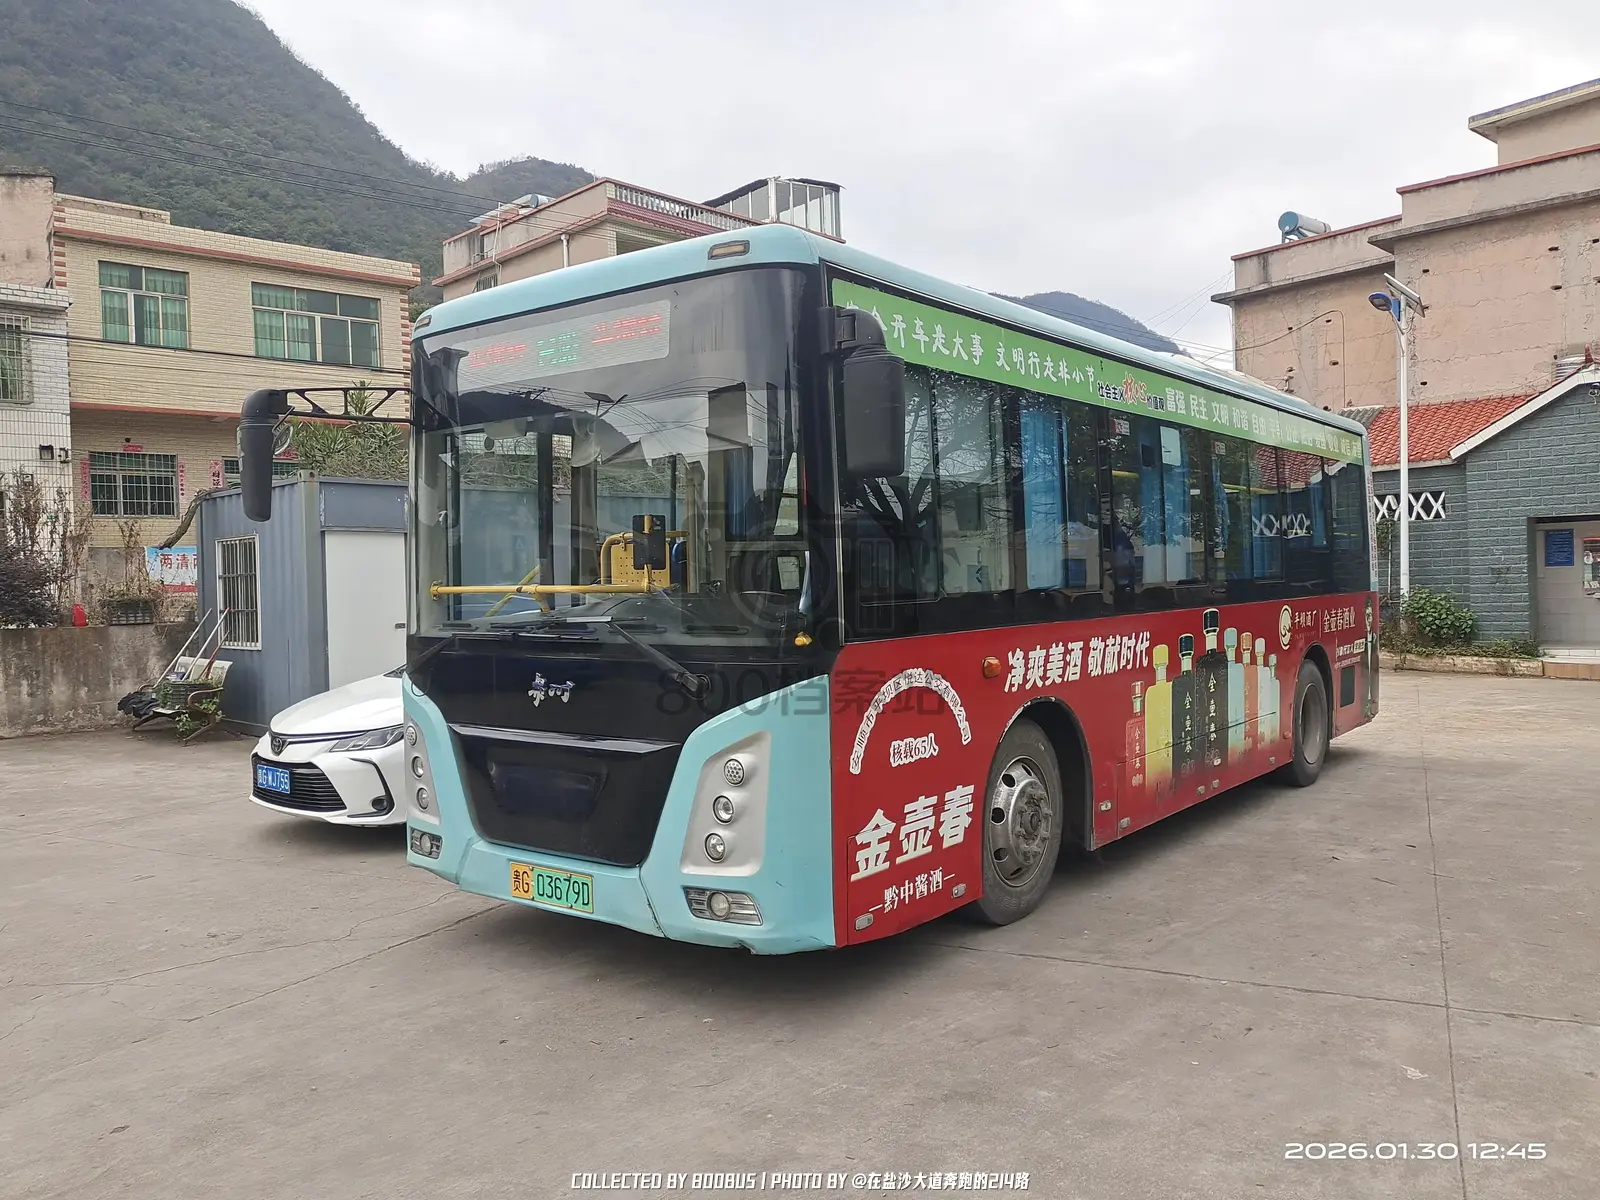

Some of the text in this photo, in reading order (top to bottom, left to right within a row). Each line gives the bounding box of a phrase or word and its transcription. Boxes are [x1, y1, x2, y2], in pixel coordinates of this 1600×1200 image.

[846, 300, 984, 365] 开车是大事
[1165, 386, 1186, 415] 富强
[1189, 394, 1208, 421] 民主
[1211, 401, 1229, 426] 文明
[1232, 406, 1248, 431] 和谐
[1323, 606, 1356, 633] 金壶春酒业
[1004, 630, 1150, 693] 净爽美酒 敬献时代
[892, 735, 938, 764] 核载65人
[850, 784, 975, 883] 金壶春
